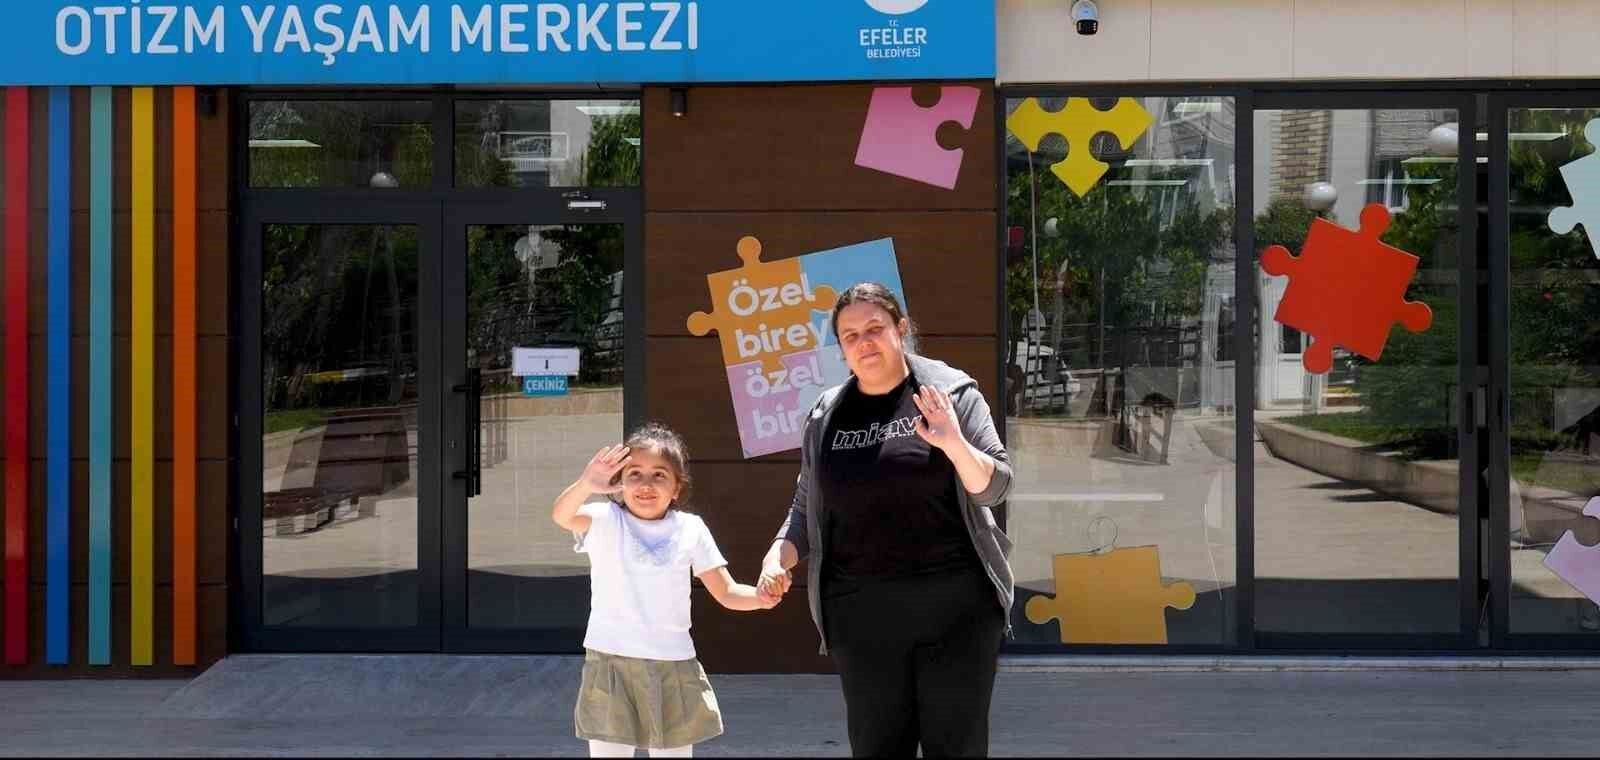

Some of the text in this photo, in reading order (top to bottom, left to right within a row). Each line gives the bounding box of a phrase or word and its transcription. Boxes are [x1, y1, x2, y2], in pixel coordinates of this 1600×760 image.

[56, 0, 225, 55] OTİZM
[241, 4, 430, 66] YAŞAM
[859, 27, 927, 46] EFELER
[866, 46, 921, 58] BELEDİYESİ
[728, 272, 816, 317] Özel
[735, 318, 829, 359] birey
[526, 377, 565, 394] ÇEKİNİZ
[745, 355, 824, 398] özel
